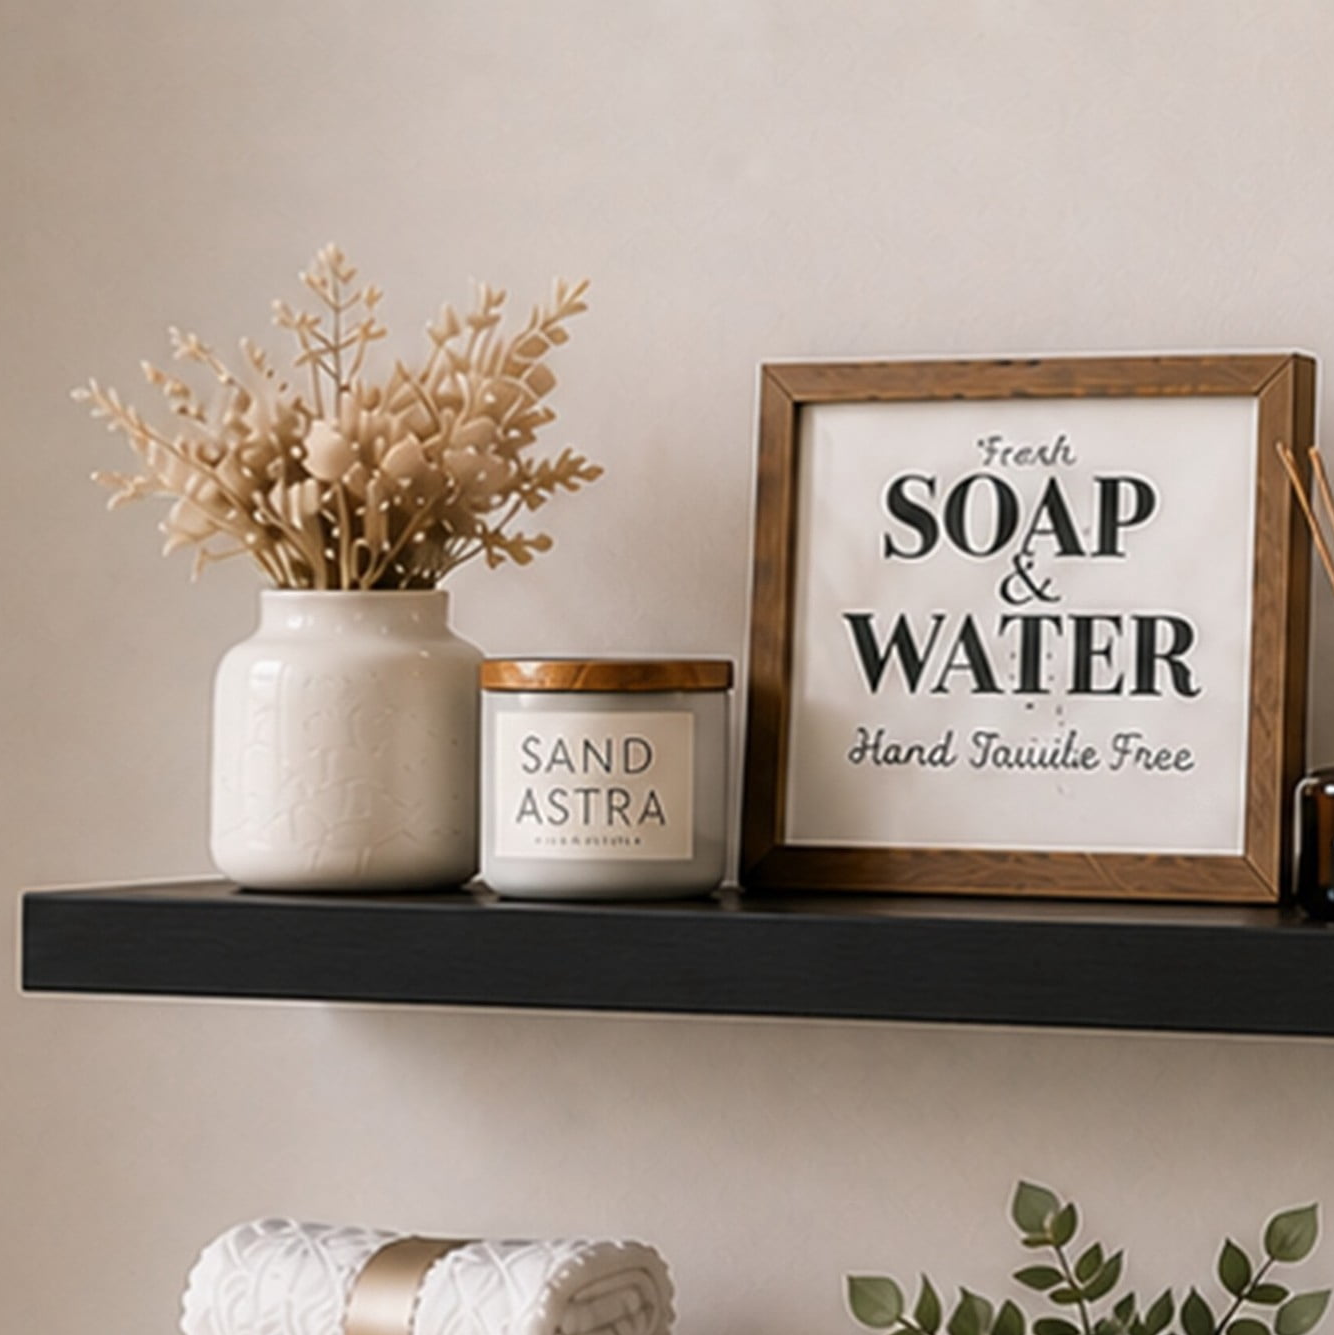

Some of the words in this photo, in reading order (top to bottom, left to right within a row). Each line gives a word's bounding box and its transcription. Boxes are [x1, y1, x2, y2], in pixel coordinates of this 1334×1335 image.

[884, 473, 1157, 559] SOAP
[998, 554, 1062, 606] &
[842, 612, 1201, 698] WATER
[521, 736, 653, 774] SAND
[847, 727, 957, 768] Hand
[1109, 733, 1196, 772] Free
[515, 788, 667, 828] ASTRA
